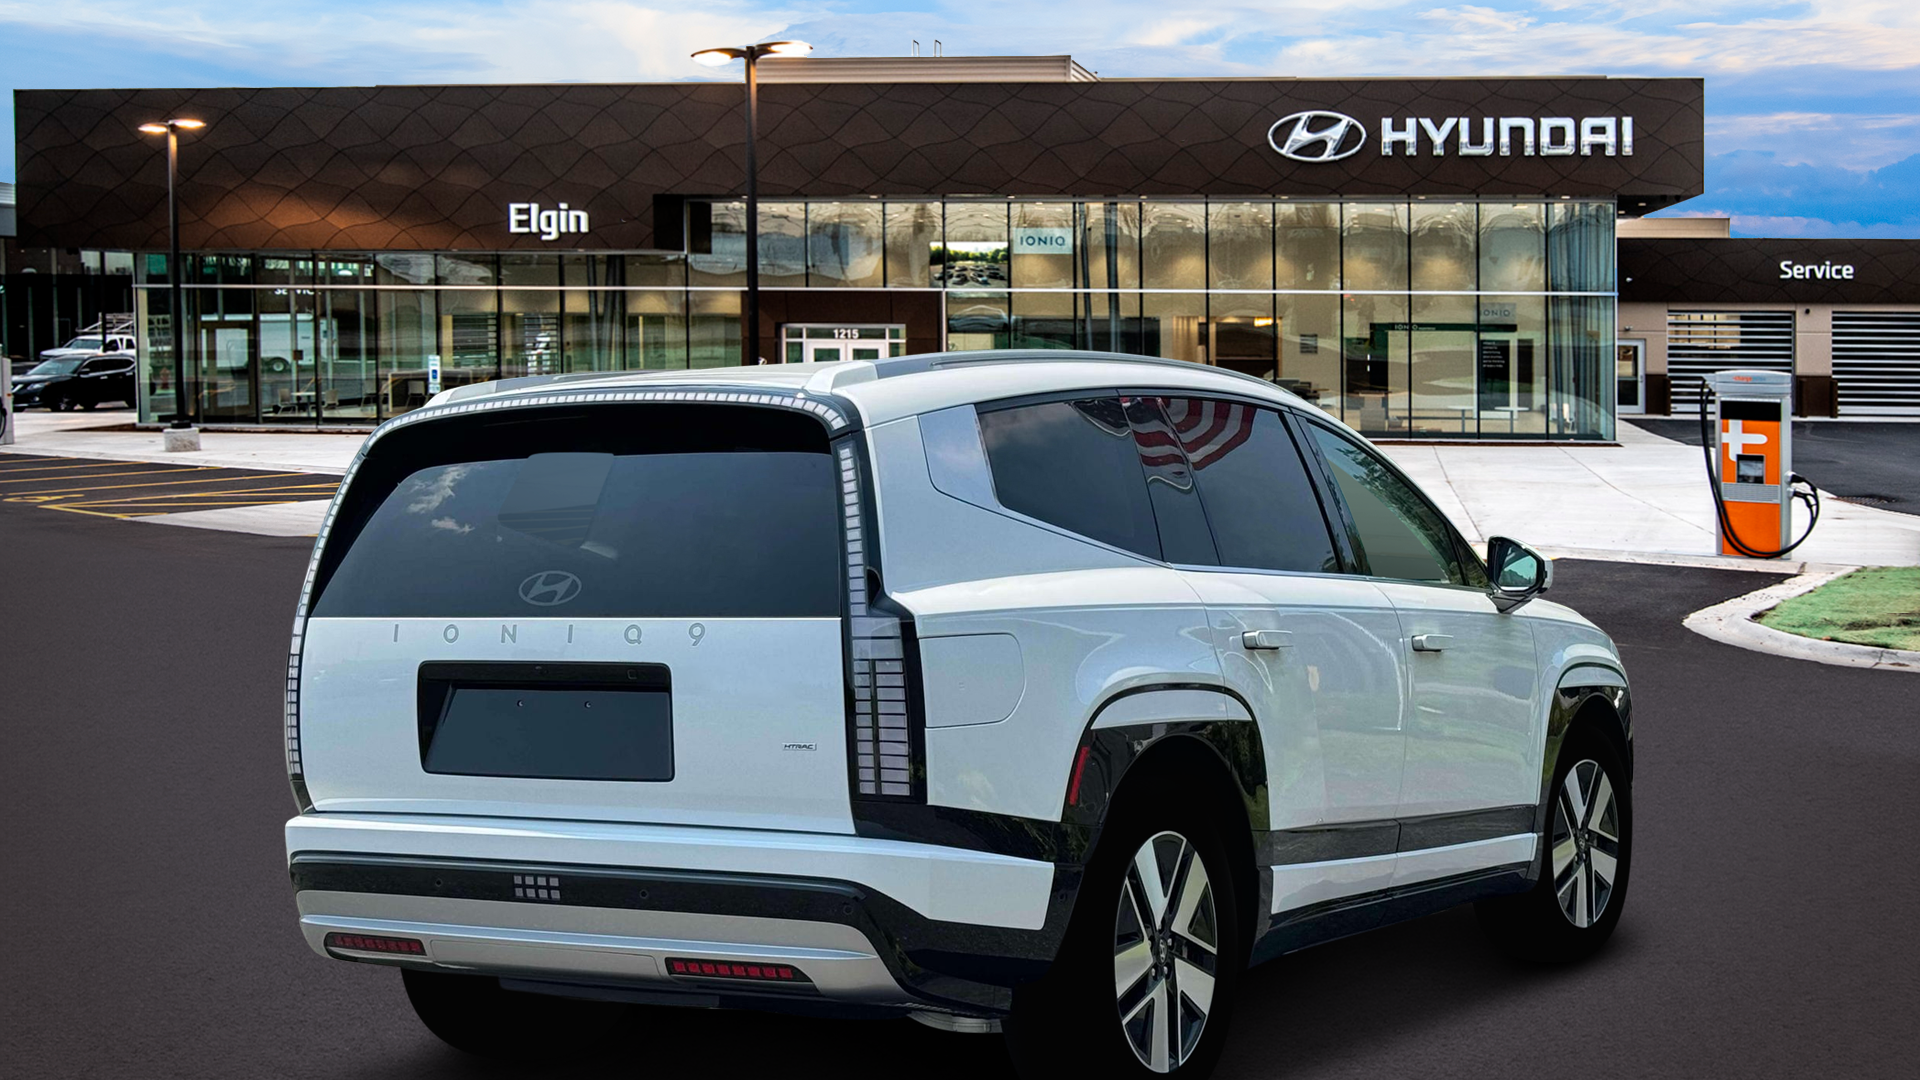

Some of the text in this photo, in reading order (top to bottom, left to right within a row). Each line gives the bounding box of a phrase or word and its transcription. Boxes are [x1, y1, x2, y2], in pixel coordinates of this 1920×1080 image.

[1381, 117, 1633, 156] HYUNDAI
[508, 202, 590, 240] Elgin
[1020, 235, 1066, 247] IONIQ
[1780, 261, 1854, 279] Service
[833, 328, 859, 339] 1215
